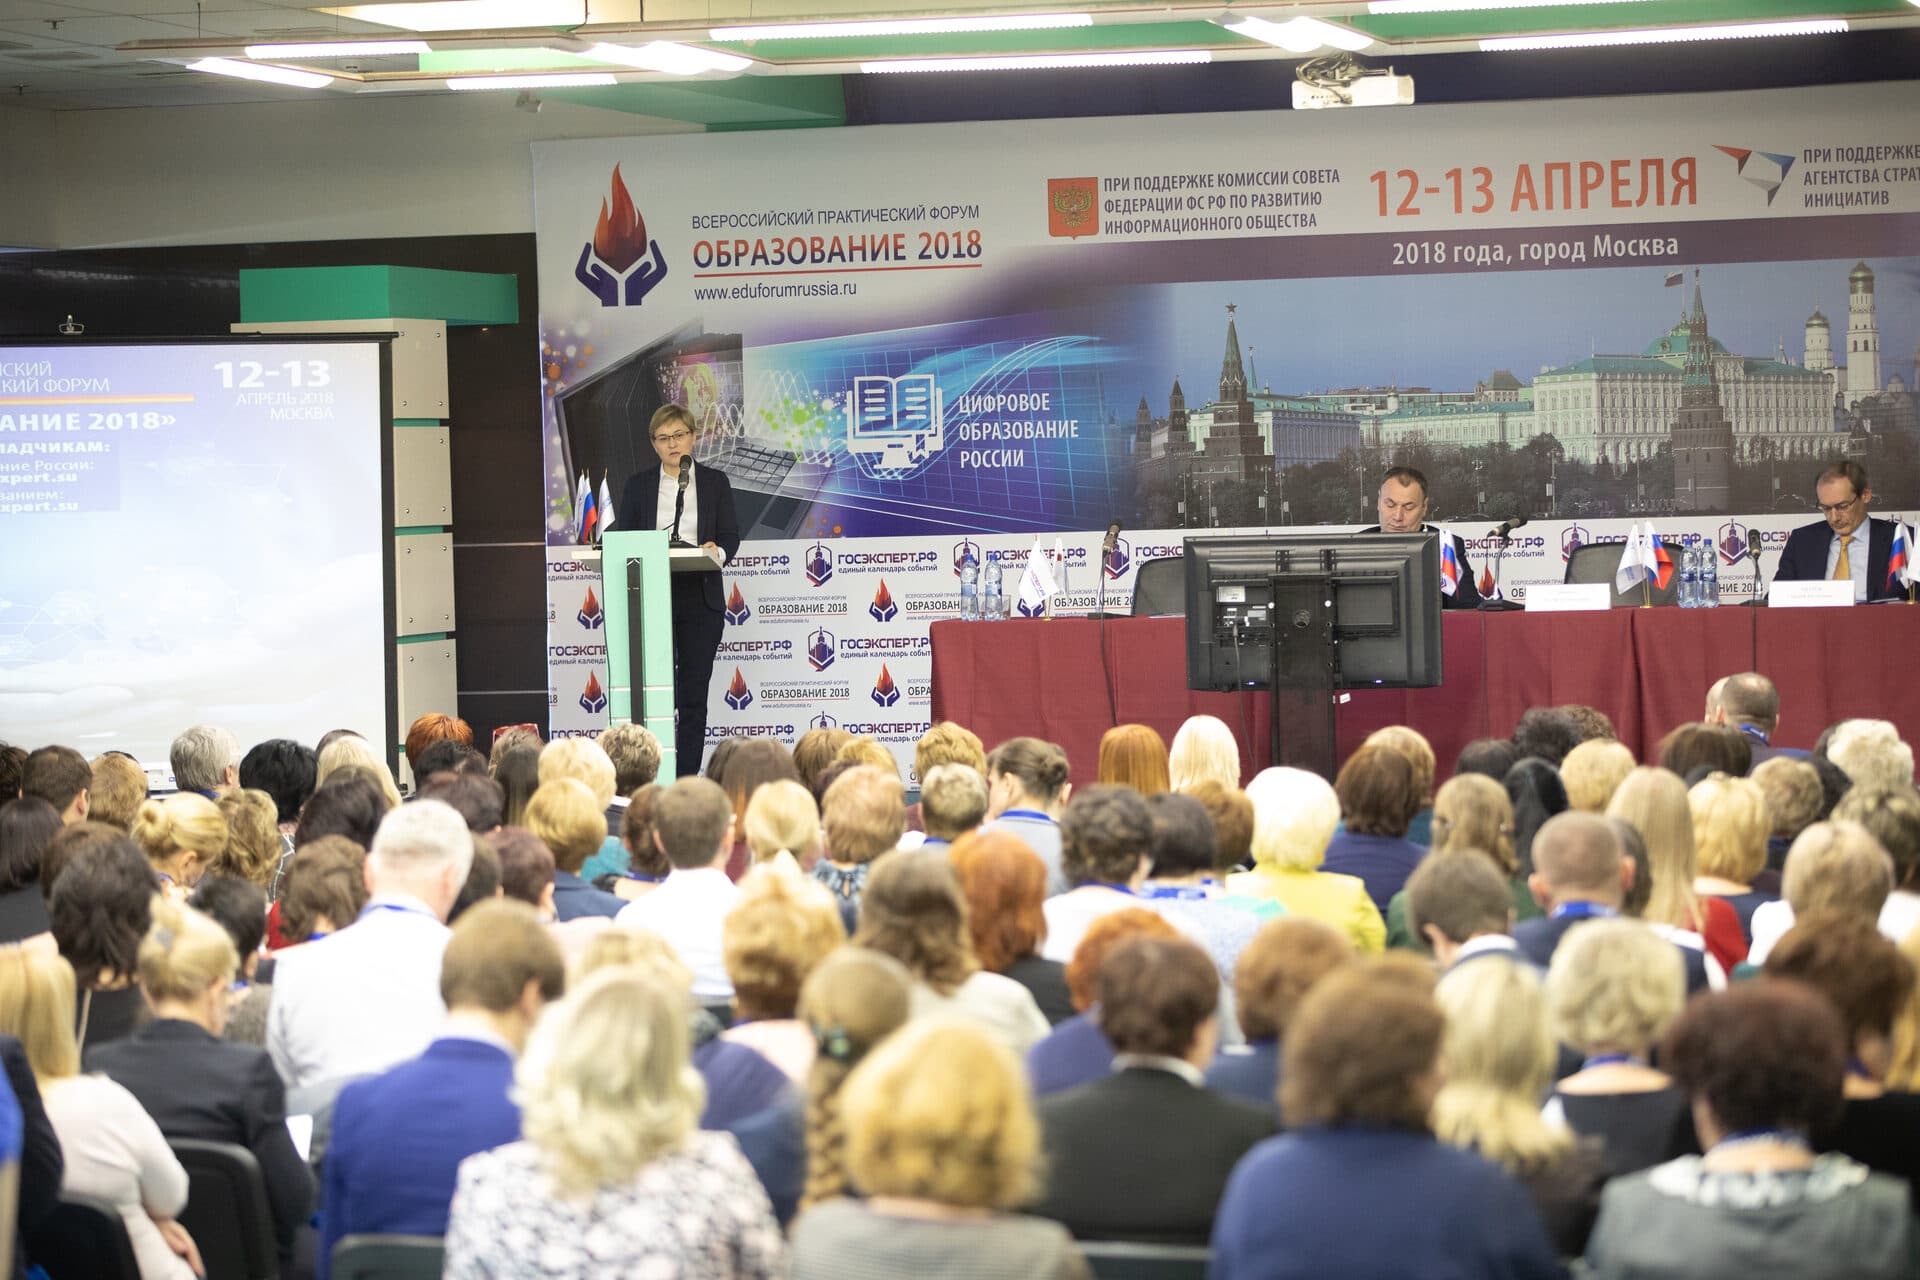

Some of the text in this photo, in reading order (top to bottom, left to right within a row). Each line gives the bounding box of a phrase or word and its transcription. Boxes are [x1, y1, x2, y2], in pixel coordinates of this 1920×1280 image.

[1804, 144, 1920, 163] ПРИ ПОДДЕРЖКЕ
[1104, 169, 1340, 193] ПРИ ПОДДЕРЖКЕ КОМИССИИ СОВЕТА
[1369, 156, 1697, 217] 12-13 АПРЕЛЯ
[1804, 169, 1880, 186] АГЕНТСТВА
[1104, 191, 1322, 215] ФЕДЕРАЦИИ ФС РФ ПО РАЗВИТИЮ
[1804, 190, 1890, 208] ИНИЦИАТИВ
[692, 204, 980, 229] ВСЕРОССИЙСКИЙ ПРАКТИЧЕСКИЙ ФОРУМ
[1104, 213, 1317, 235] ИНФОРМАЦИОННОГО ОБЩЕСТВА
[693, 229, 983, 268] ОБРАЗОВАНИЕ 2018
[1392, 234, 1679, 267] 2018 года, город Москва
[694, 281, 857, 300] www.eduforumrussia.ru
[214, 360, 331, 388] 12-13
[43, 377, 111, 393] ФОРУМ
[236, 391, 297, 406] АПРЕЛЬ
[958, 393, 1050, 416] ЦИФРОВОЕ
[88, 411, 177, 430] 2018»
[270, 407, 334, 421] МОСКВА
[959, 420, 1079, 441] ОБРАЗОВАНИЕ
[960, 449, 1024, 469] РОССИИ
[838, 551, 937, 565] ГОСЭКСПЕРТ.РФ
[1513, 550, 1545, 558] событий
[761, 567, 790, 576] событий
[838, 563, 938, 574] единый календарь событий
[758, 602, 847, 614] ОБРАЗОВАНИЕ 2018
[1054, 596, 1121, 607] ОБРАЗОВНИЕ
[840, 637, 931, 649] ГОСЭКСПЕРТ.Р
[723, 654, 761, 662] календарь
[763, 652, 792, 660] событий
[840, 650, 868, 658] единый
[870, 650, 908, 658] календарь
[761, 687, 849, 699] ОБРАЗОВАНИЕ 2018
